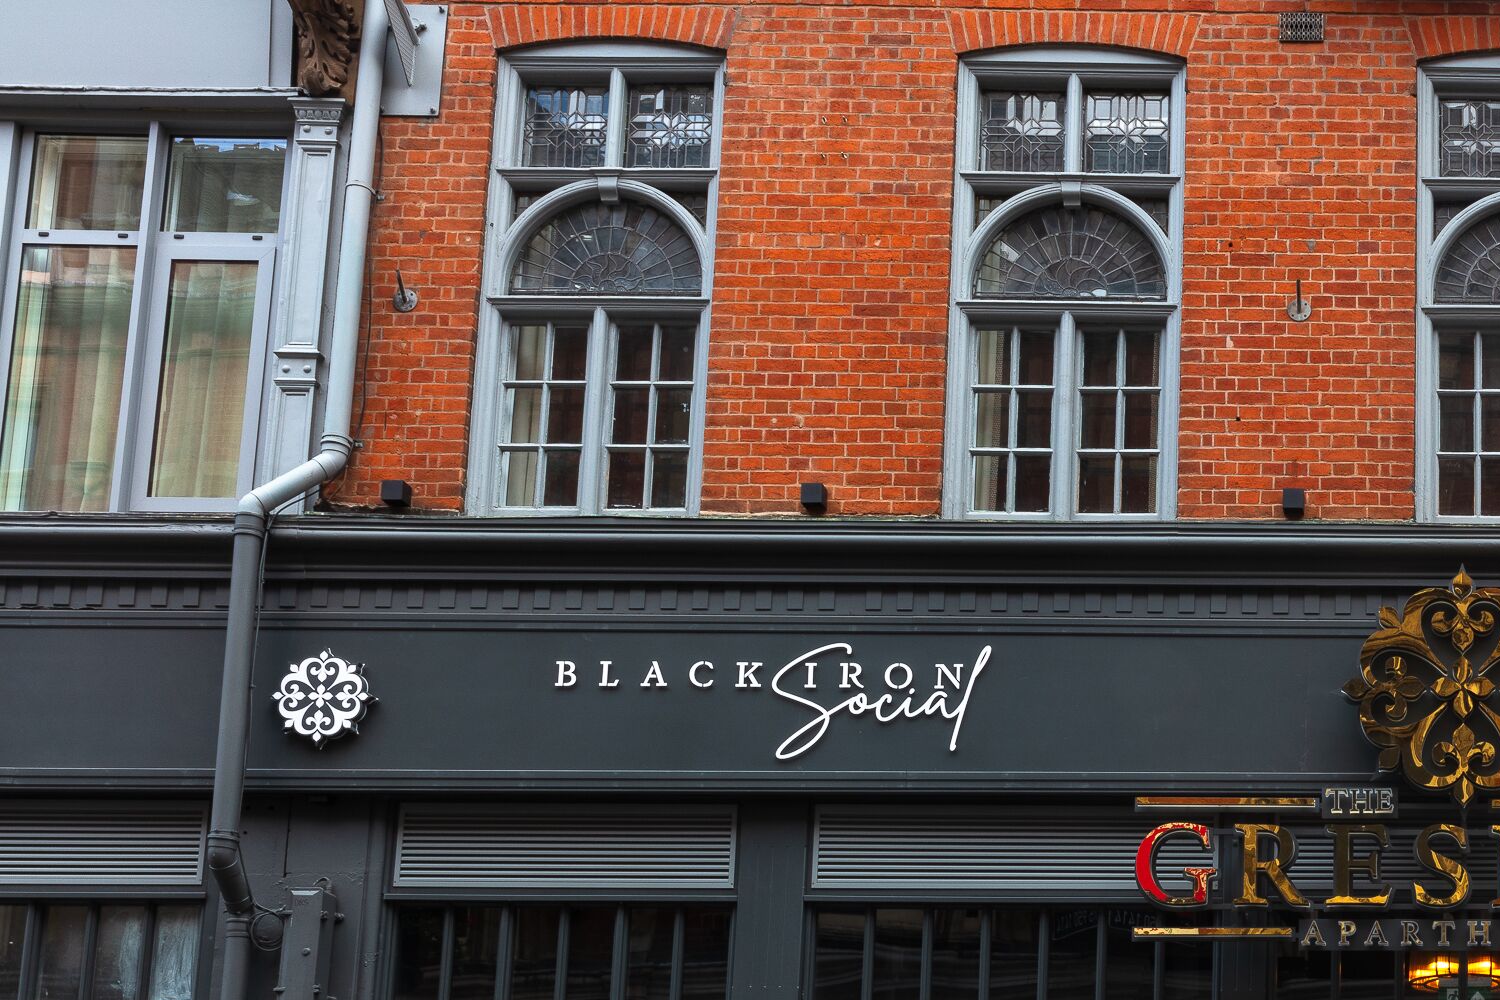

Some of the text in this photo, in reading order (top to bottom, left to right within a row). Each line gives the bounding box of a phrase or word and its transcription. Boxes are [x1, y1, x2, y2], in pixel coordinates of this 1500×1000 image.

[555, 660, 764, 688] BLACK
[772, 642, 992, 760] Social
[1324, 787, 1394, 815] THE
